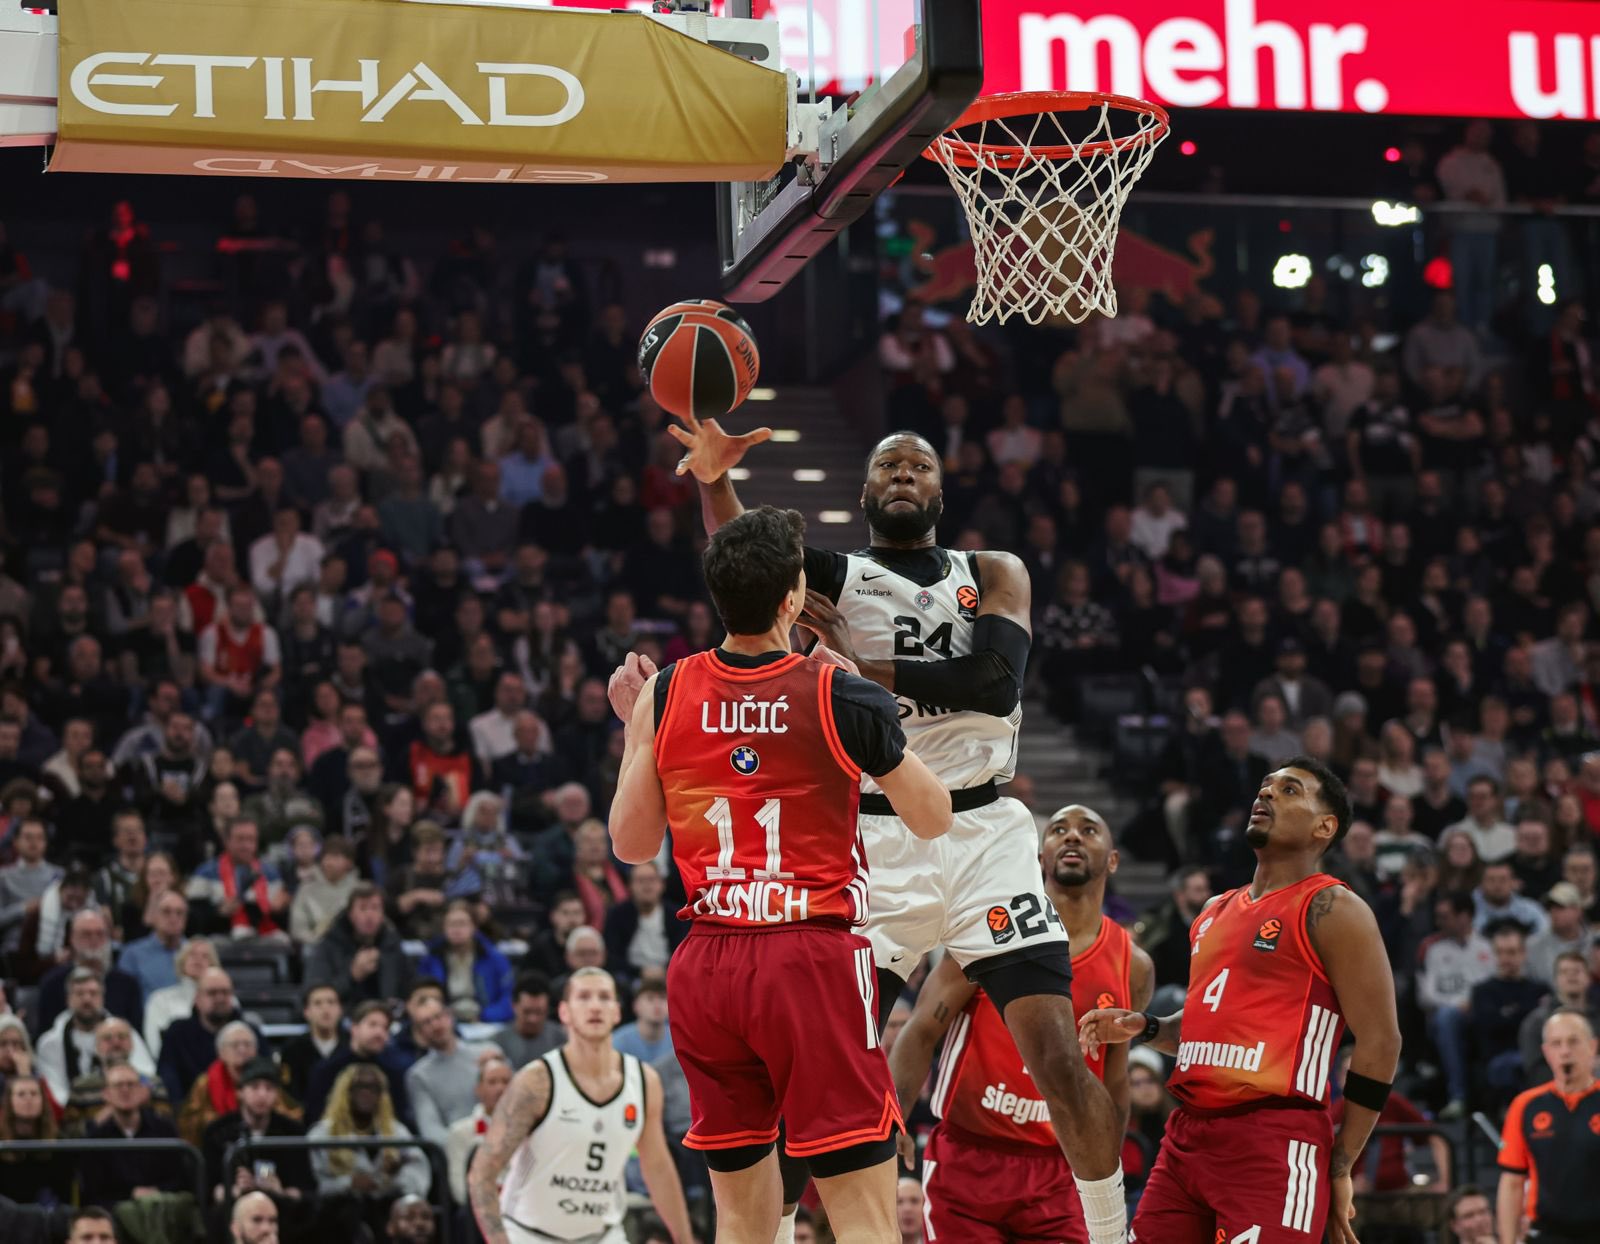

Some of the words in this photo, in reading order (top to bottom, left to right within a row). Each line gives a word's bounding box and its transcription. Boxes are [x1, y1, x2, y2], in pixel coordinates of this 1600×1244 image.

[1018, 0, 1389, 113] mehr.
[1508, 31, 1600, 119] u
[69, 51, 586, 127] ETIHAD
[893, 615, 953, 659] 24
[701, 694, 790, 734] LUČIĆ
[703, 796, 796, 881] 11
[1202, 968, 1230, 1012] 4
[981, 1083, 1052, 1125] siegm
[586, 1142, 606, 1172] 5
